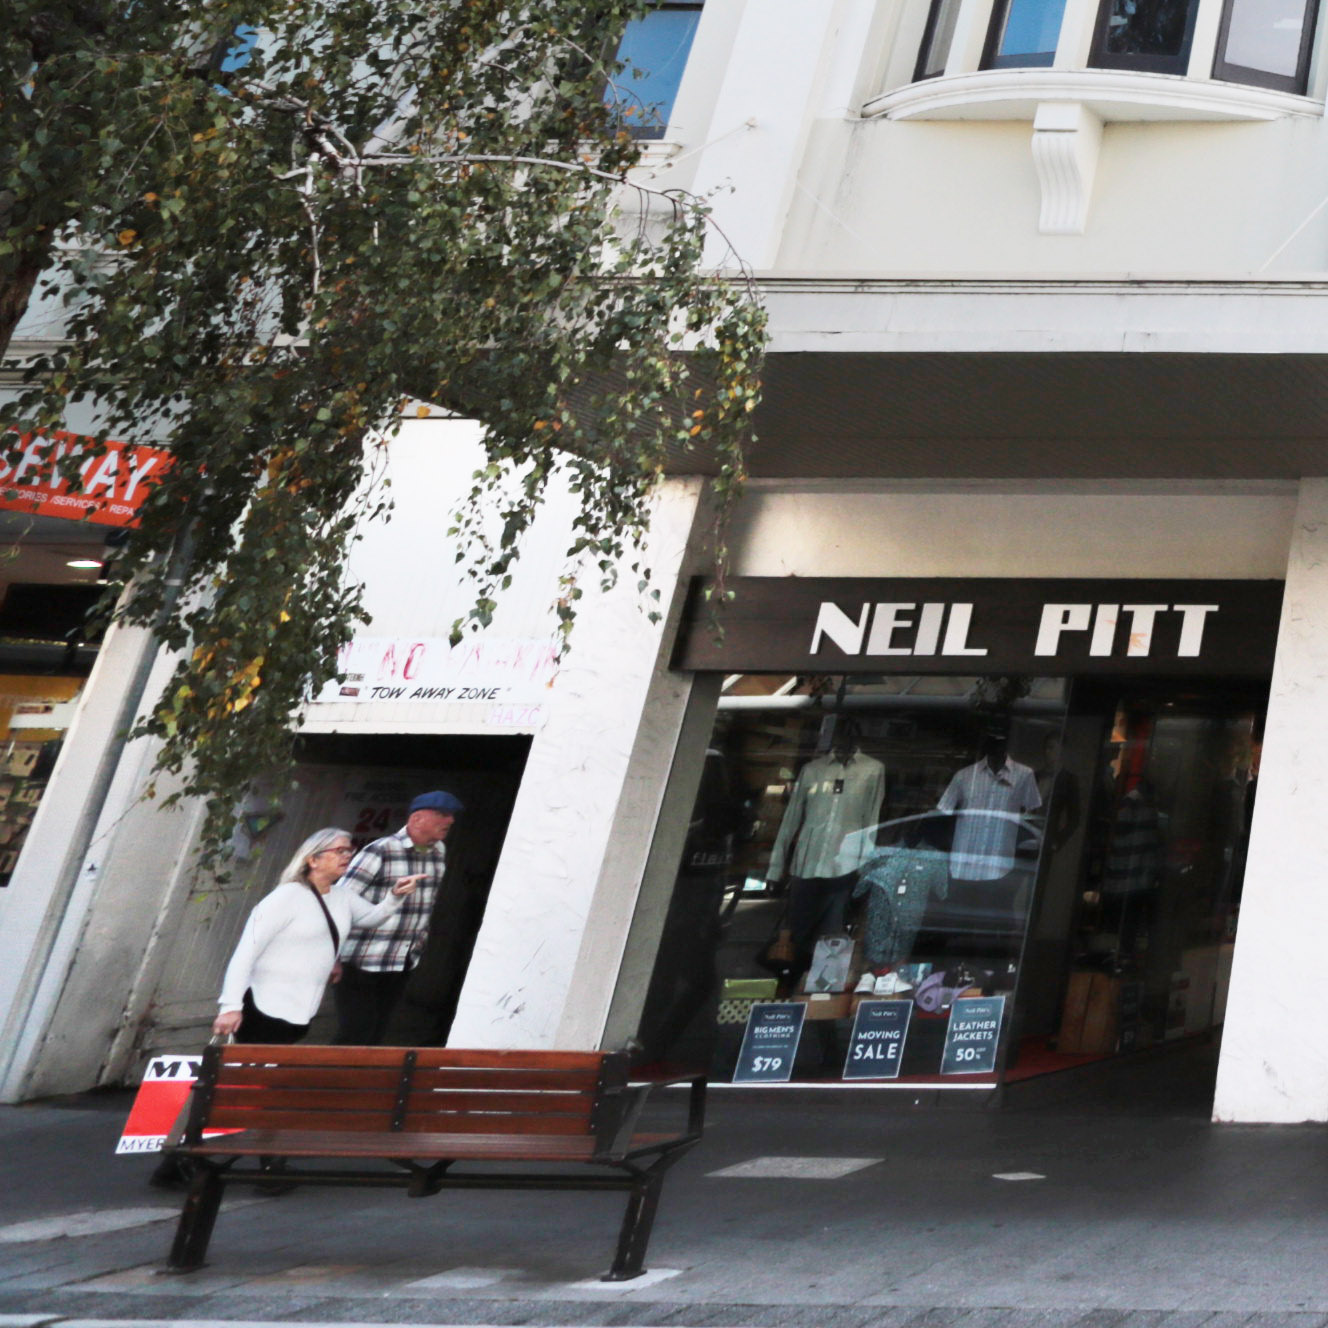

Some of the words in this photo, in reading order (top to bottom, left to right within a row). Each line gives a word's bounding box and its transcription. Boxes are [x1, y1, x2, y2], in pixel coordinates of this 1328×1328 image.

[109, 503, 137, 516] REPA
[809, 602, 988, 656] NEIL
[1034, 603, 1219, 657] PITT
[409, 686, 455, 700] AWAY
[754, 1025, 769, 1033] BIG
[953, 1020, 996, 1031] LEATHER
[857, 1030, 900, 1040] MOVING
[952, 1031, 994, 1042] JACKETS
[853, 1043, 898, 1060] SALE
[150, 1061, 203, 1078] MY
[751, 1055, 782, 1072] $79
